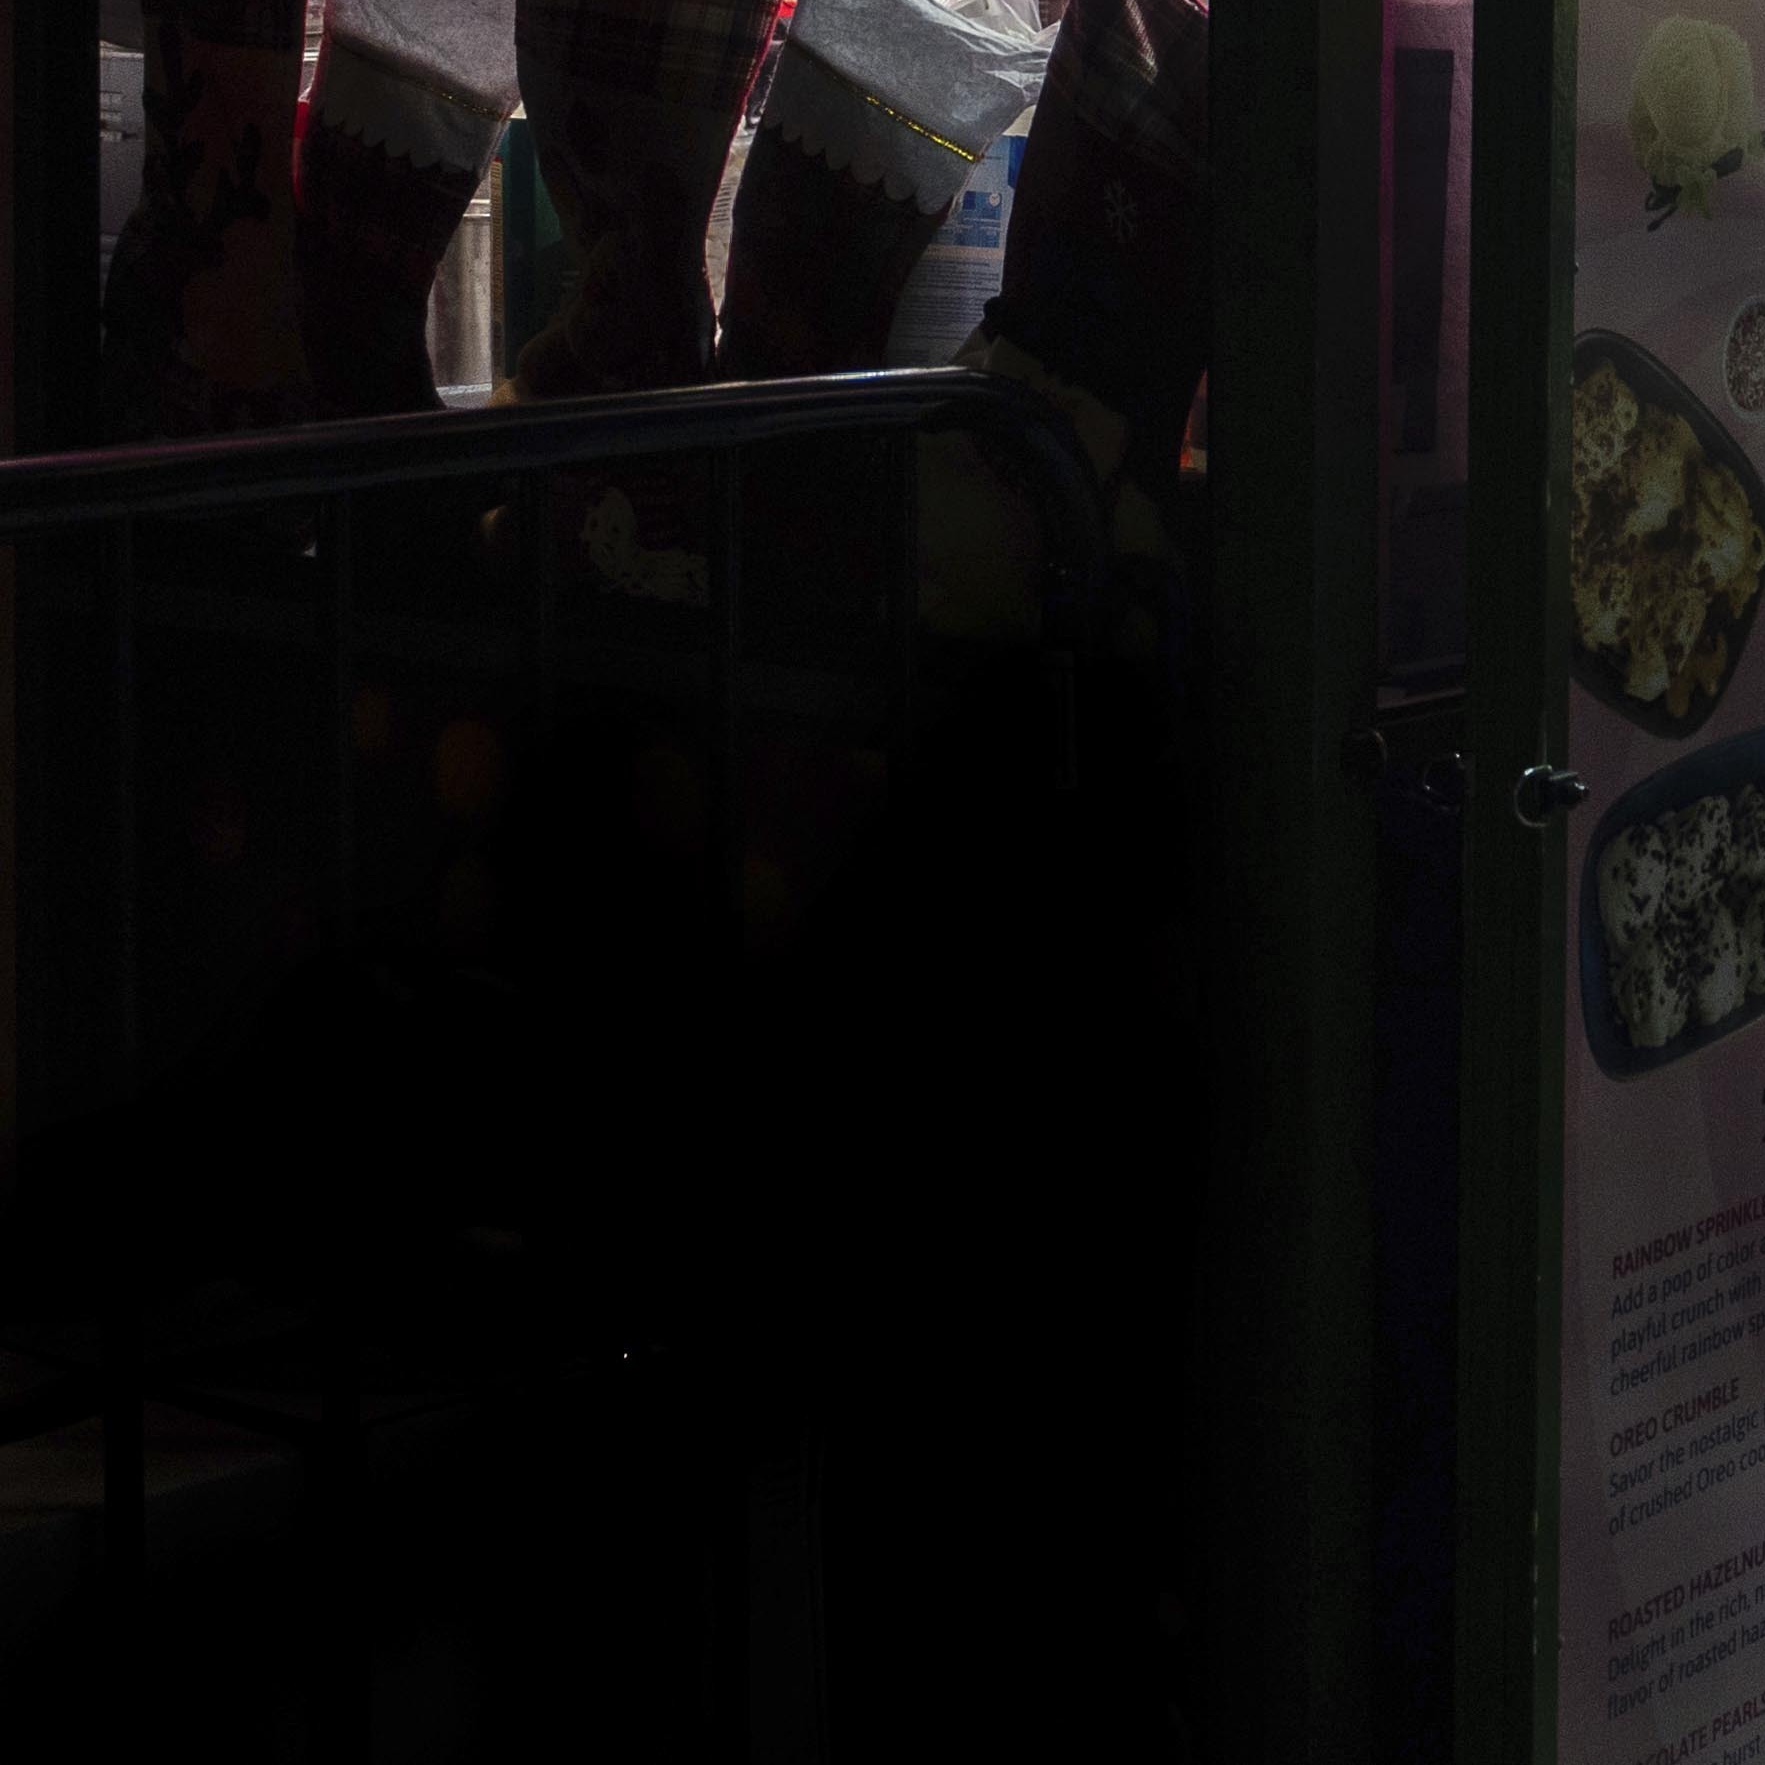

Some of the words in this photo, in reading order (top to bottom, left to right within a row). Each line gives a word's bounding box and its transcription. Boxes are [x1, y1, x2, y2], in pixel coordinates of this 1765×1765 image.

[1613, 1225, 1694, 1280] RAINBOW
[1609, 1416, 1658, 1457] OREO
[1662, 1376, 1740, 1433] CRUMBLE
[1608, 1584, 1686, 1644] ROASTED
